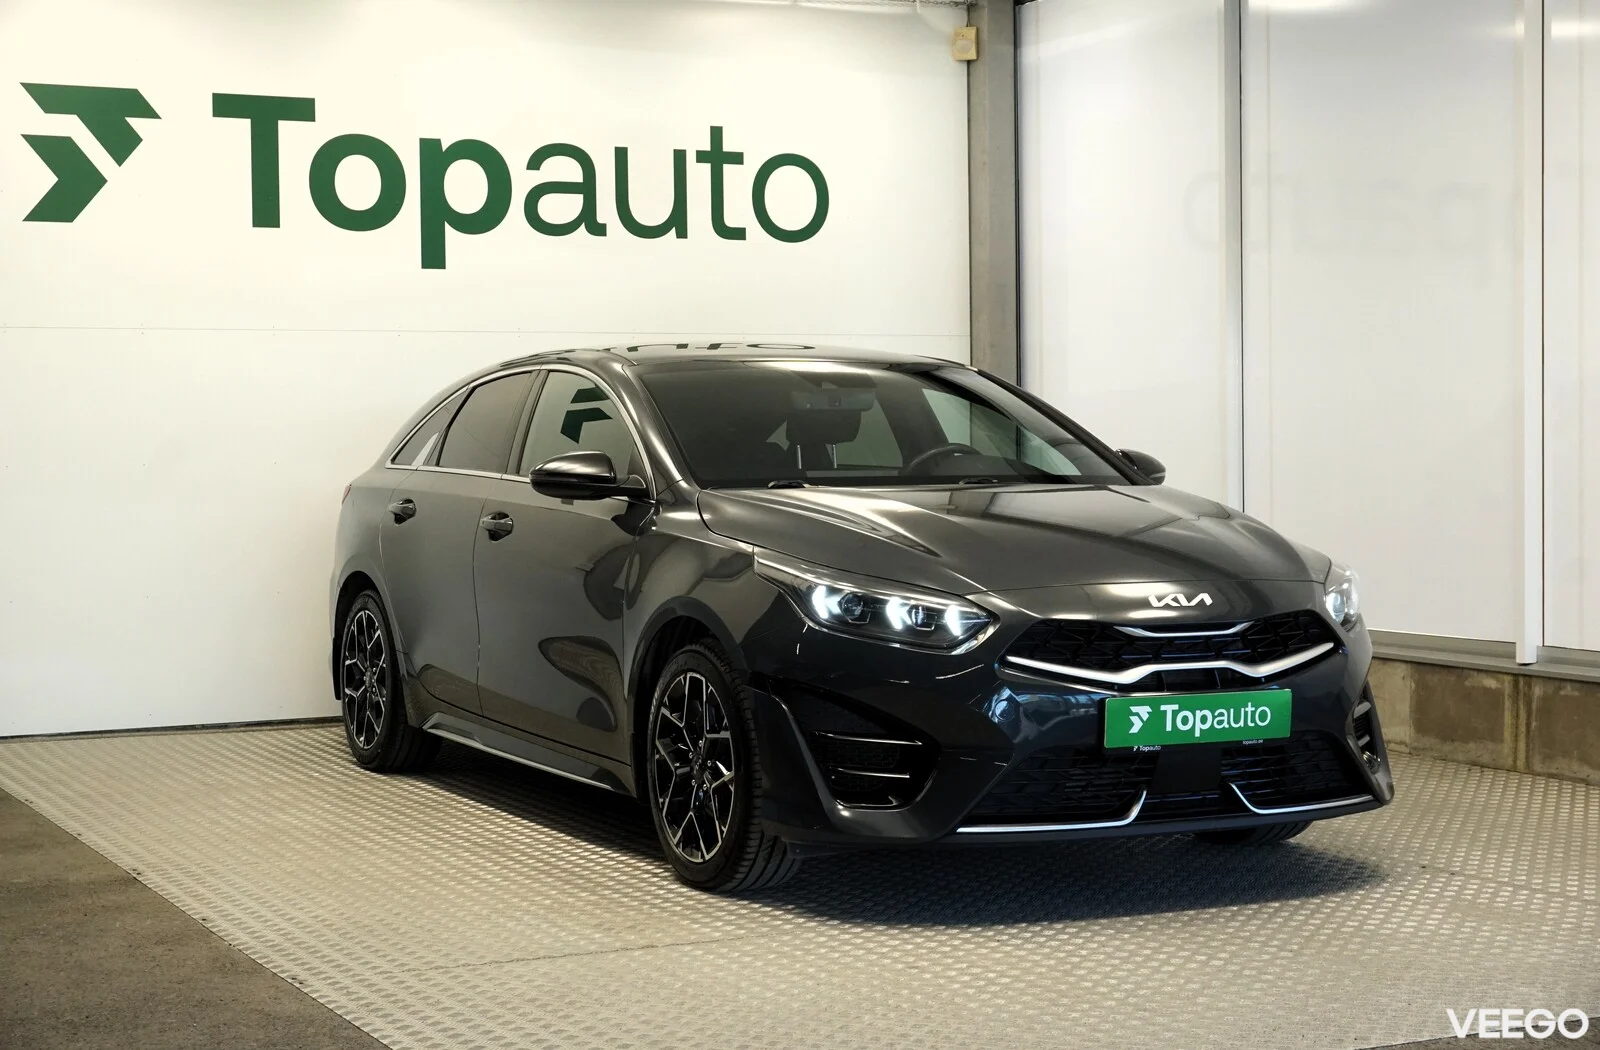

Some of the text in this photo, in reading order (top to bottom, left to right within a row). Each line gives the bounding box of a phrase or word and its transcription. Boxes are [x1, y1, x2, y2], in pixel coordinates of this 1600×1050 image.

[212, 93, 830, 270] Topauto
[1148, 593, 1213, 608] KIA
[1160, 702, 1272, 737] Topauto
